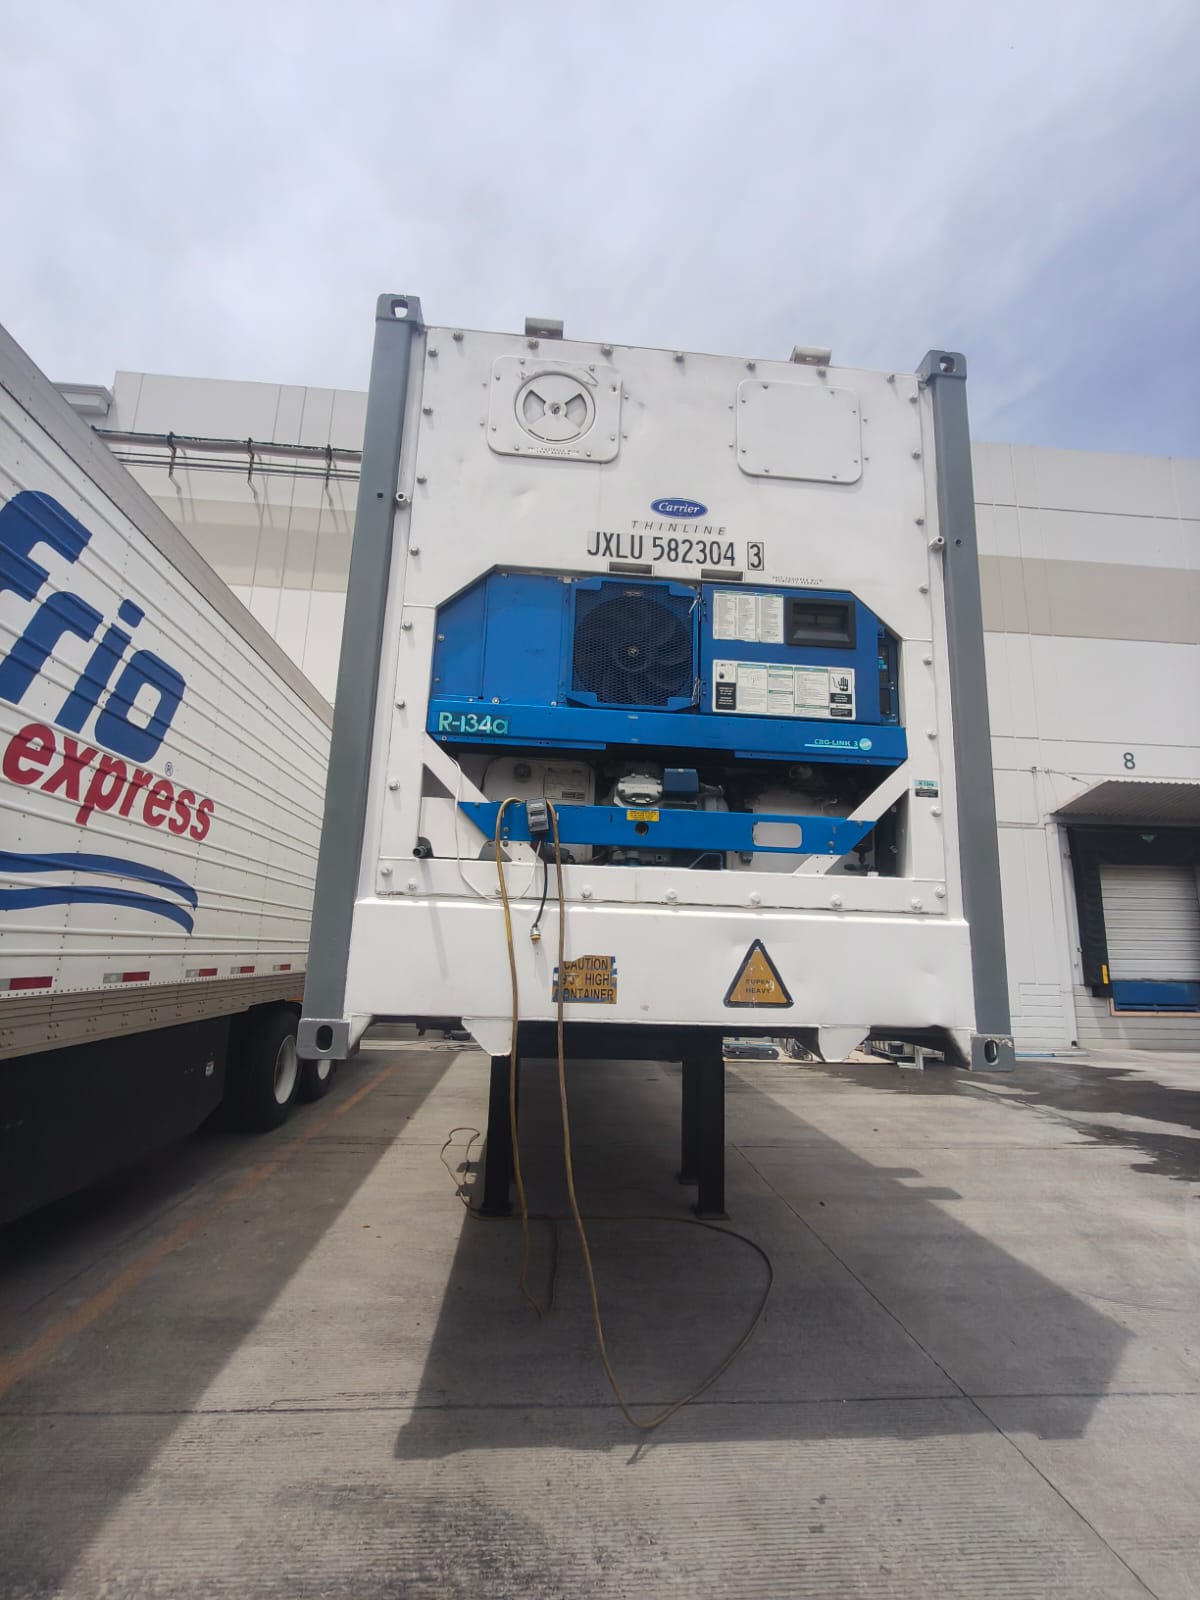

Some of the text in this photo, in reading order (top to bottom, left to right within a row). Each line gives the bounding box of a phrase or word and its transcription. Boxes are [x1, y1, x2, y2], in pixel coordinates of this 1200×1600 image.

[658, 502, 700, 514] Carrier
[631, 520, 727, 536] THINLINE
[587, 532, 762, 569] JXLU 582304 3
[0, 490, 186, 763] frio
[438, 711, 509, 735] R-134a
[1123, 752, 1136, 770] 8
[2, 723, 214, 842] express
[563, 957, 608, 971] CAUTION
[585, 972, 610, 986] HIGH
[562, 987, 614, 1001] ONTAINER
